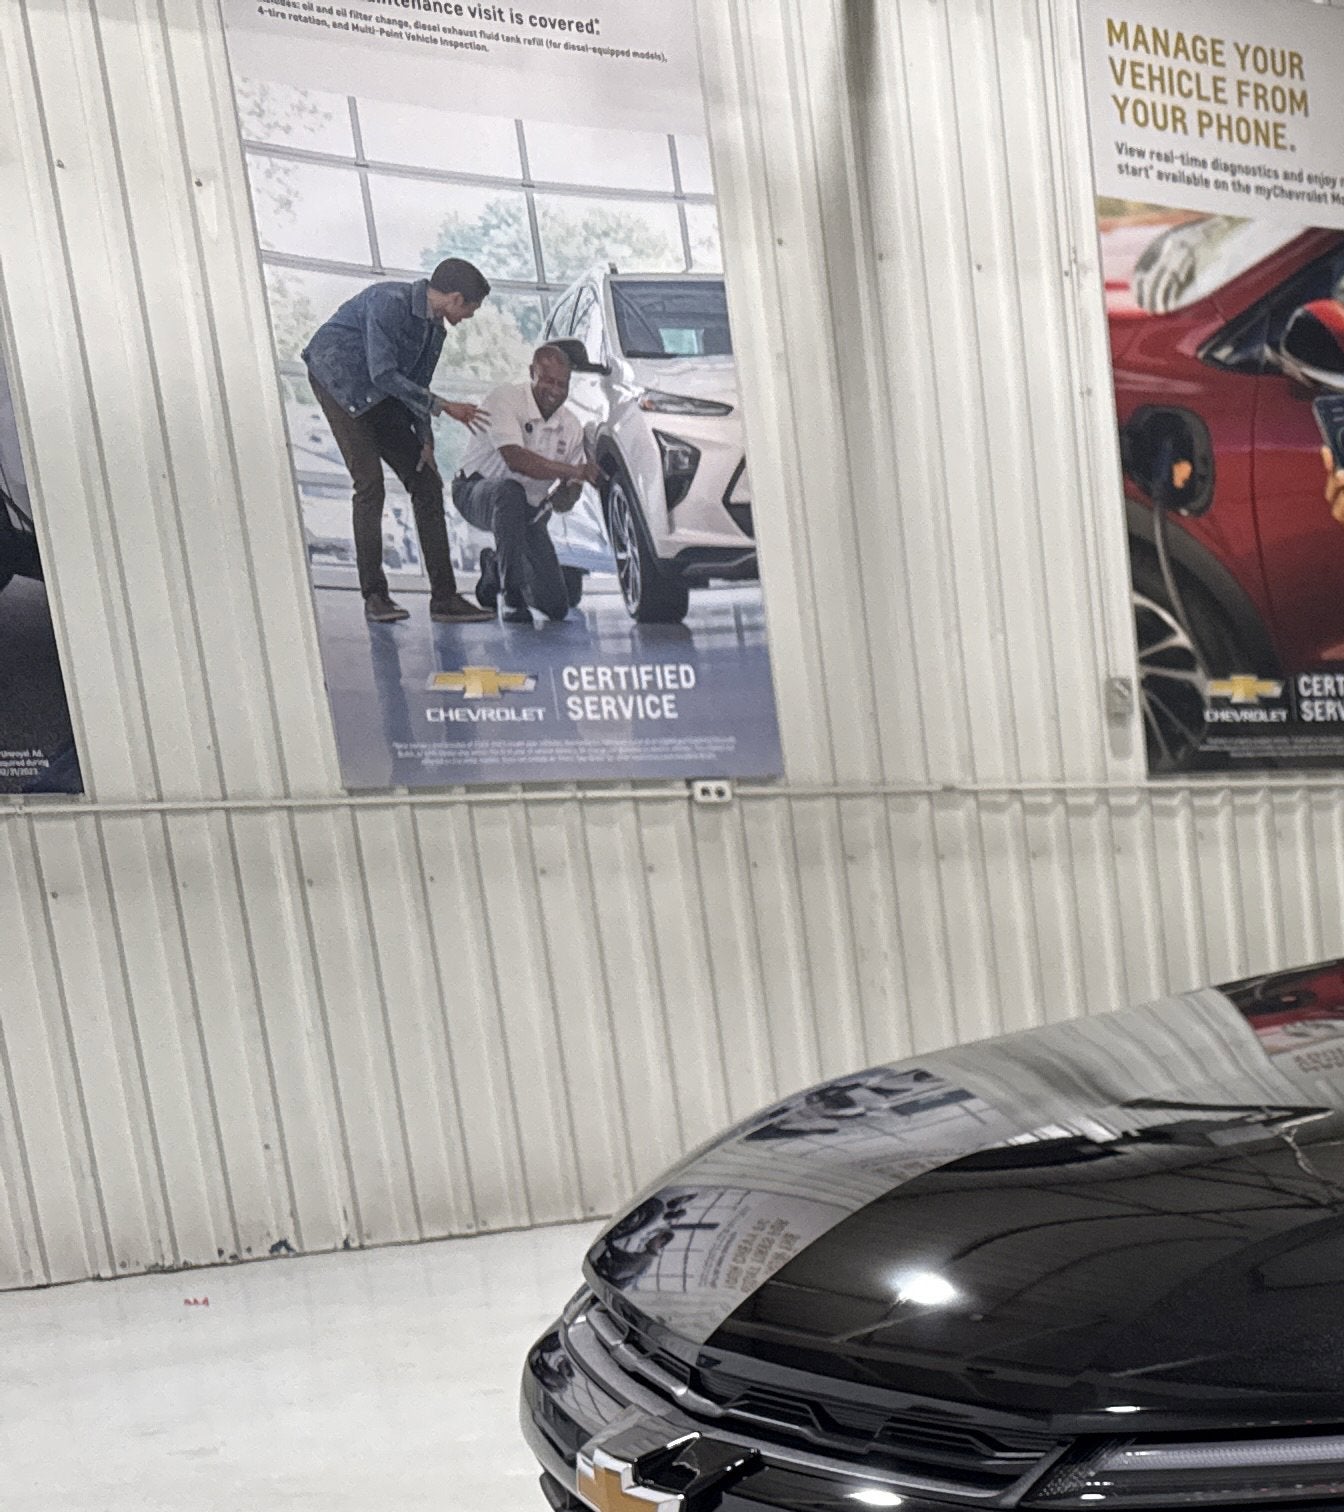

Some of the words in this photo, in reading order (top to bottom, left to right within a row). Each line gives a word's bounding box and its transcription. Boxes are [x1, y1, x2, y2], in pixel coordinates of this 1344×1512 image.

[257, 6, 287, 19] 4-tire
[332, 21, 349, 30] and
[352, 22, 403, 39] Multi-Point
[404, 31, 438, 45] Vehicle
[302, 3, 314, 11] oil
[316, 5, 333, 15] and
[335, 8, 347, 17] oil
[349, 9, 372, 21] filter
[375, 14, 412, 29] change,
[414, 20, 440, 32] diesel
[442, 26, 477, 38] exhaust
[479, 29, 499, 41] fluid
[501, 33, 521, 44] tank
[523, 37, 543, 47] refill
[546, 38, 561, 49] (for
[367, 0, 464, 16] tenance
[468, 3, 505, 22] visit
[510, 8, 524, 25] is
[1106, 18, 1226, 67] MANAGE
[1233, 41, 1306, 81] YOUR
[1108, 56, 1228, 104] VEHICLE
[1236, 79, 1309, 118] FROM
[1111, 94, 1188, 136] YOUR
[1197, 109, 1297, 152] PHONE.
[1114, 142, 1145, 159] View
[1149, 149, 1208, 169] real-time
[1211, 156, 1280, 180] diagnostics
[1283, 168, 1304, 183] and
[1307, 171, 1337, 189] enjoy
[1157, 169, 1210, 189] available
[1214, 178, 1229, 191] on
[1231, 180, 1251, 194] the
[1255, 185, 1328, 205] myChevrolet
[562, 664, 696, 691] CERTIFIED
[426, 707, 546, 723] CHEVROLET
[566, 693, 679, 721] SERVICE
[1203, 708, 1288, 723] CHEVROLET
